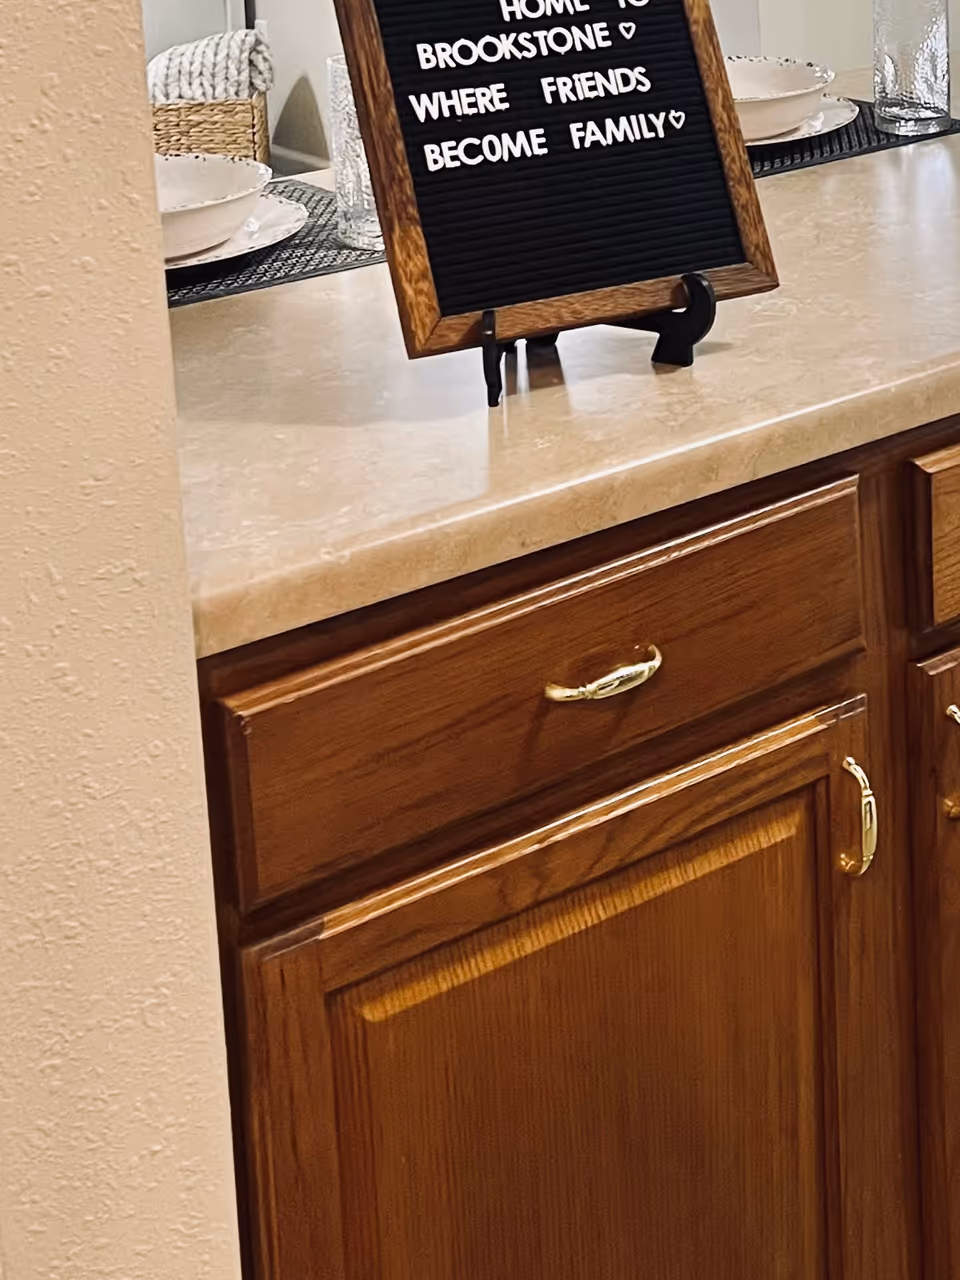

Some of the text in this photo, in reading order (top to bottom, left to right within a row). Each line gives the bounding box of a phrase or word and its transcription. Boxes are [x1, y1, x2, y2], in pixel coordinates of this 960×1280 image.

[416, 22, 612, 70] BROOKSTONE
[408, 83, 510, 123] WHERE
[569, 111, 667, 149] FAMILY
